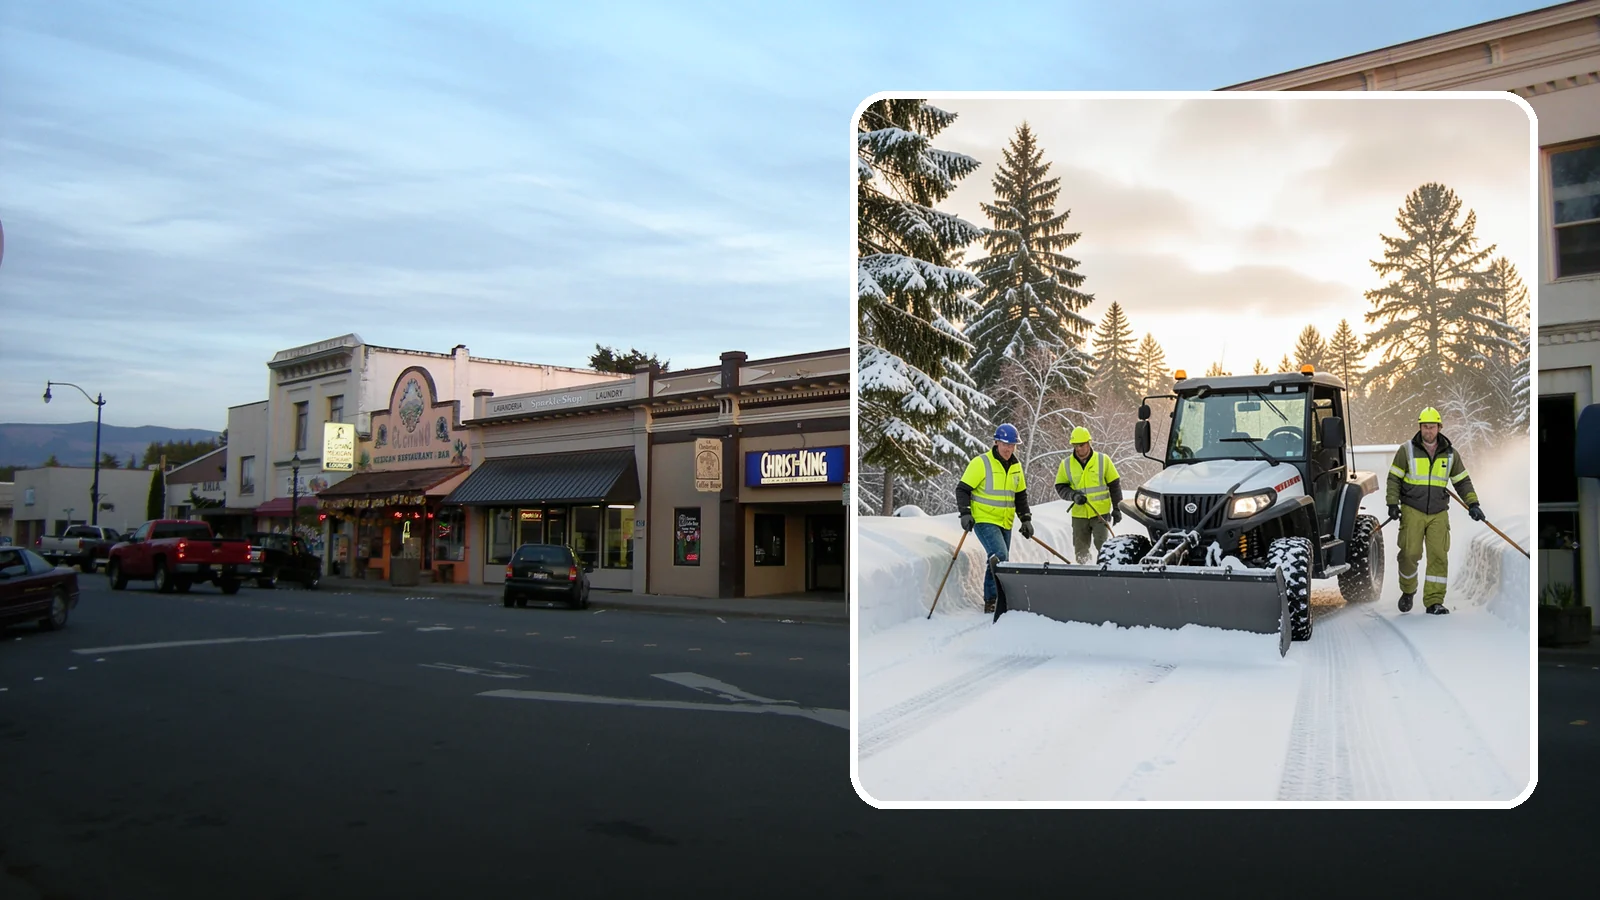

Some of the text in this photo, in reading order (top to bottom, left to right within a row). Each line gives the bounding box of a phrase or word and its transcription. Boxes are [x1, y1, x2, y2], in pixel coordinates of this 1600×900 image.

[493, 389, 624, 412] LAVANDERIA Sparkle Shop LAUNDRY
[397, 451, 433, 462] RESTAURANT
[437, 450, 450, 459] BAR
[761, 450, 827, 478] CHRIST KING
